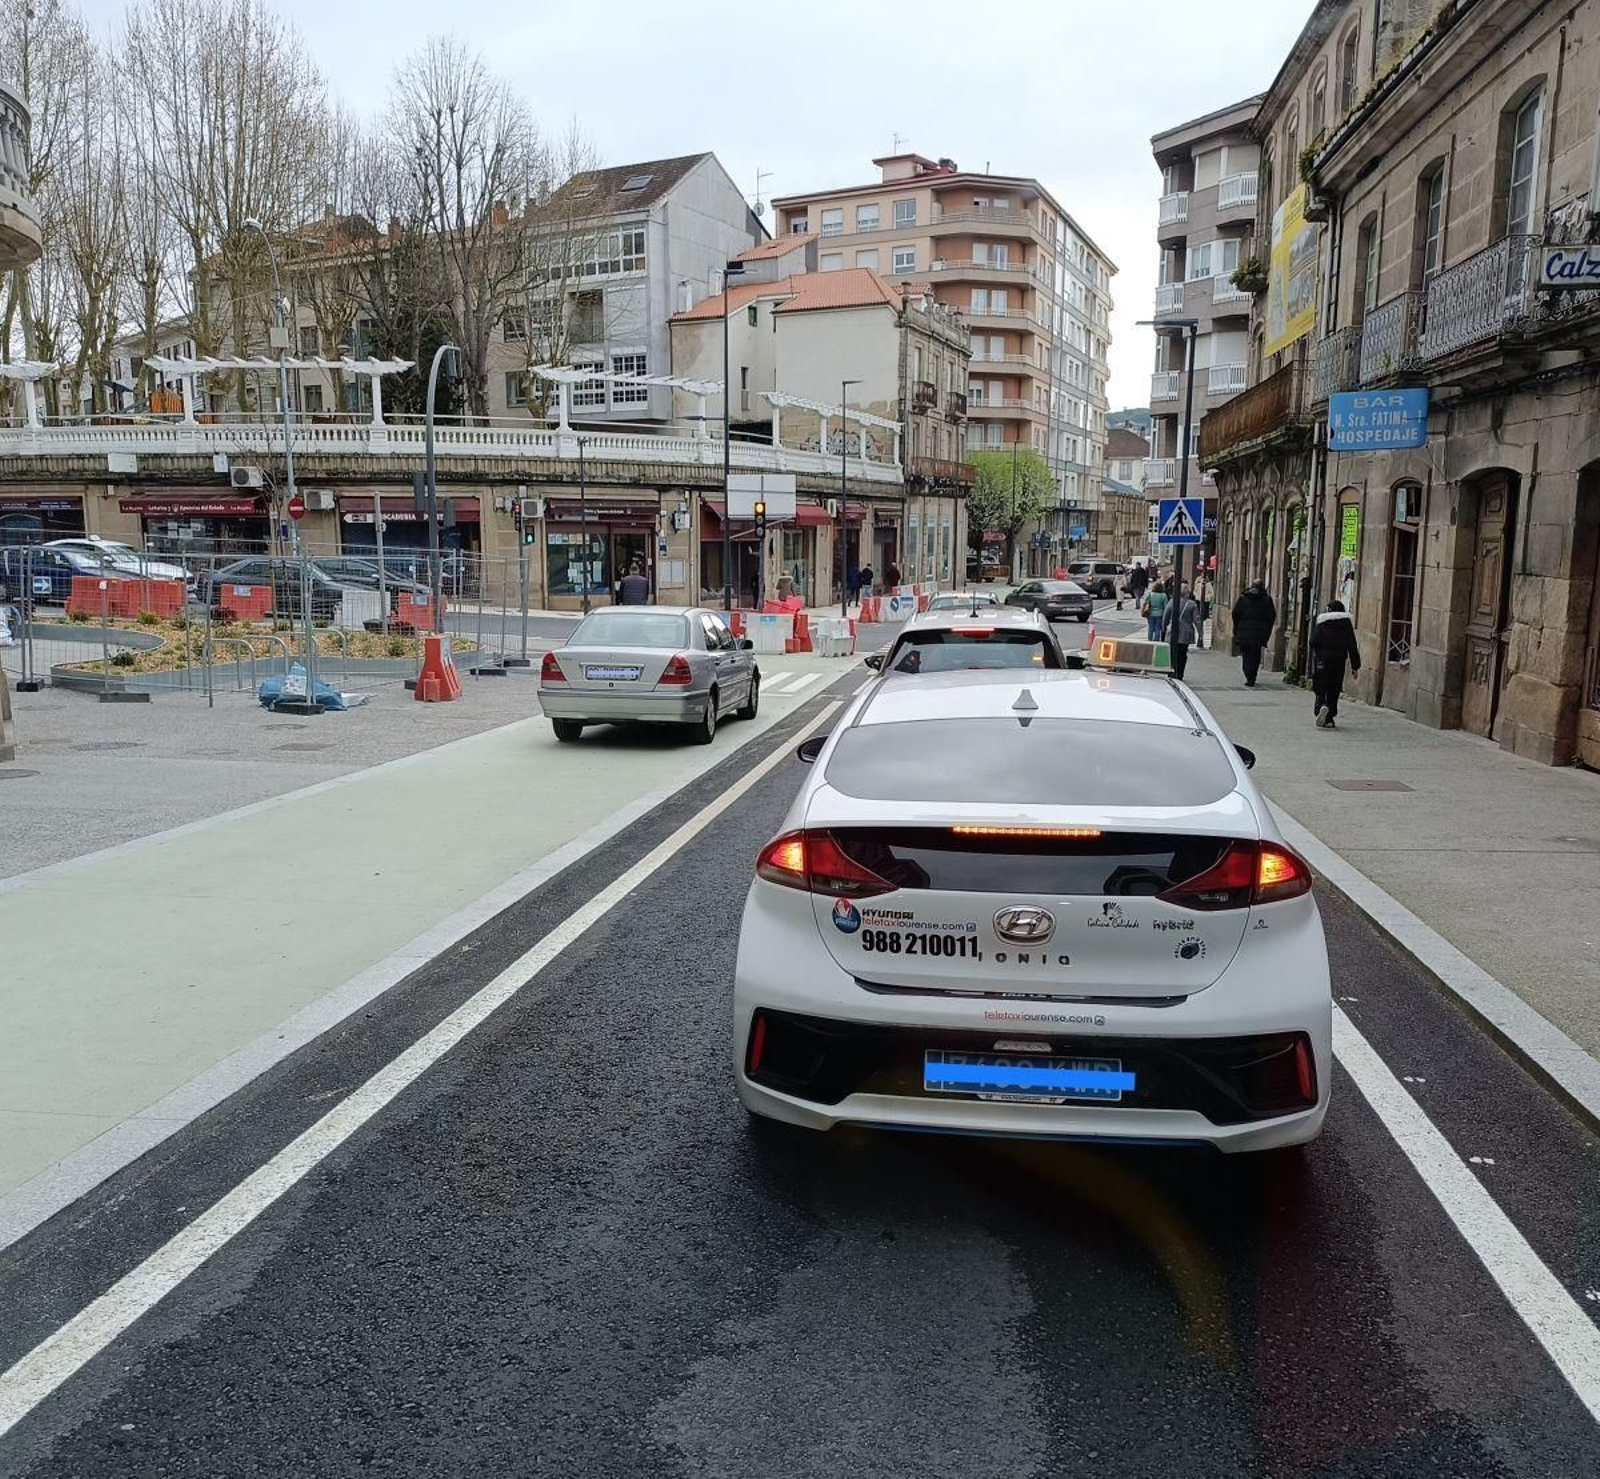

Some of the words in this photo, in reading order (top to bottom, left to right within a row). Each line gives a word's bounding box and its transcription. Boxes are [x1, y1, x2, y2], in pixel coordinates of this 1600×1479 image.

[1353, 395, 1405, 409] BAR
[1337, 428, 1418, 444] HOSPEDAJE
[862, 917, 965, 931] teletaxiourense.com
[862, 930, 902, 953] 988
[905, 933, 978, 957] 210011
[984, 1010, 1093, 1025] teletaxiourense.com
